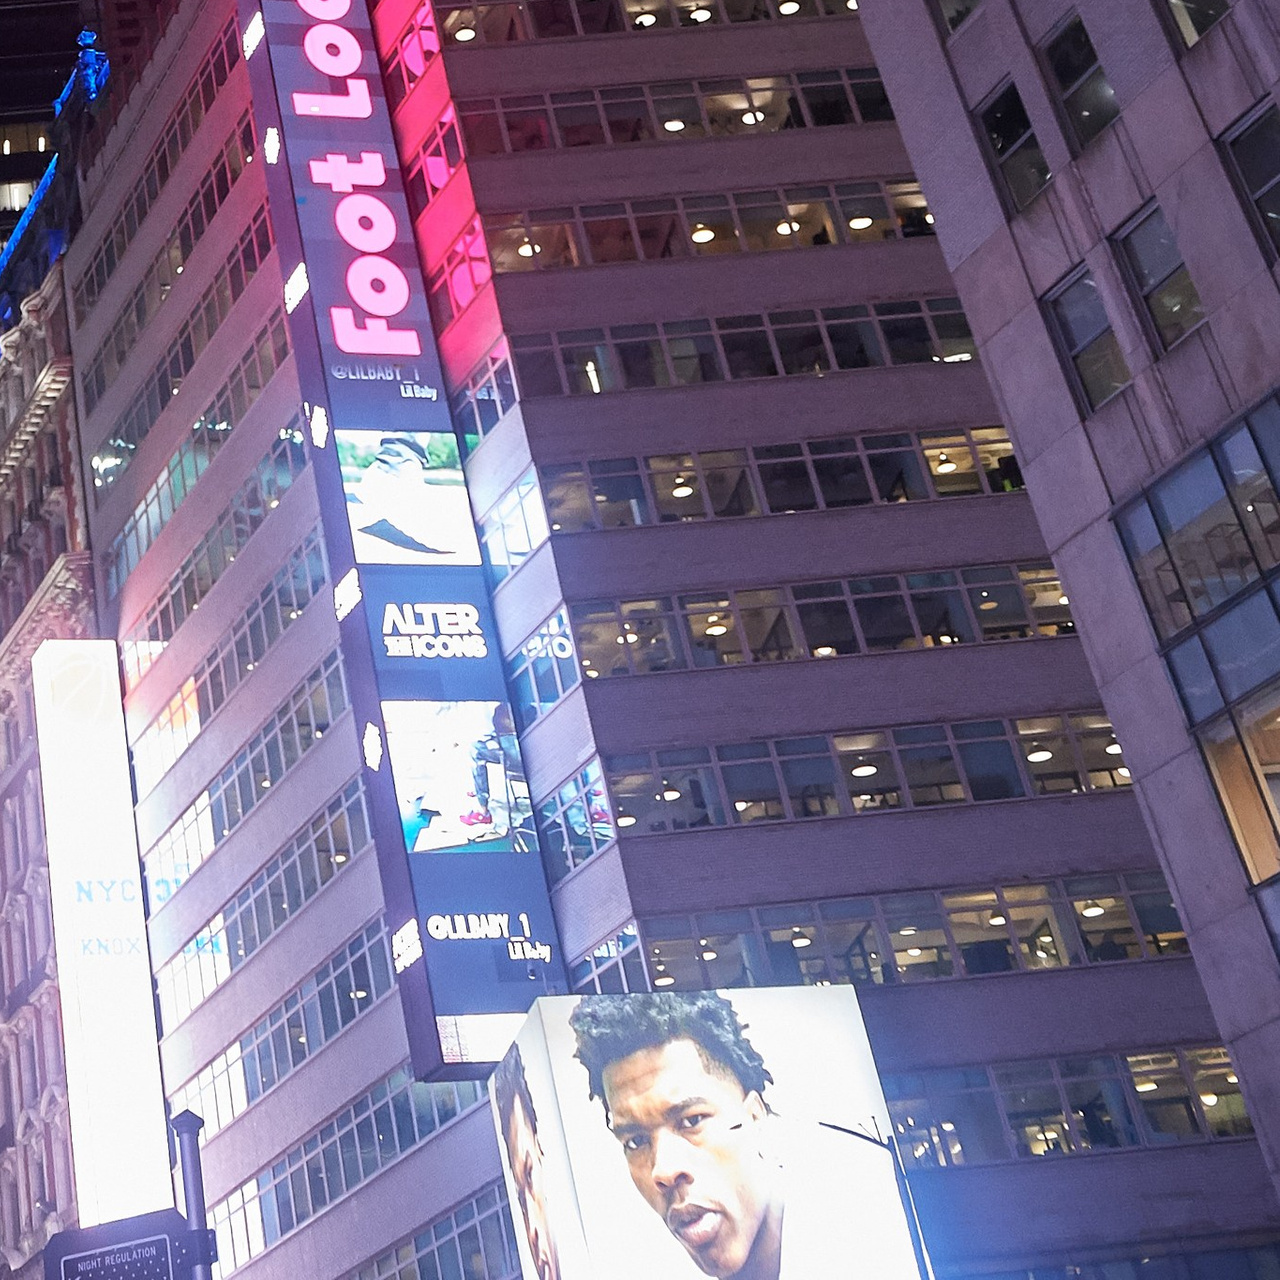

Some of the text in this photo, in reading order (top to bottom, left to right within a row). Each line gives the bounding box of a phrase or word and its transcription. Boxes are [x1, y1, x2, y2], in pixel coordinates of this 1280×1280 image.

[309, 151, 421, 356] Foot
[382, 603, 483, 635] ALTER
[412, 634, 488, 658] ICONS
[75, 879, 135, 902] NYC
[77, 1246, 157, 1272] NIGHT REGULATION
